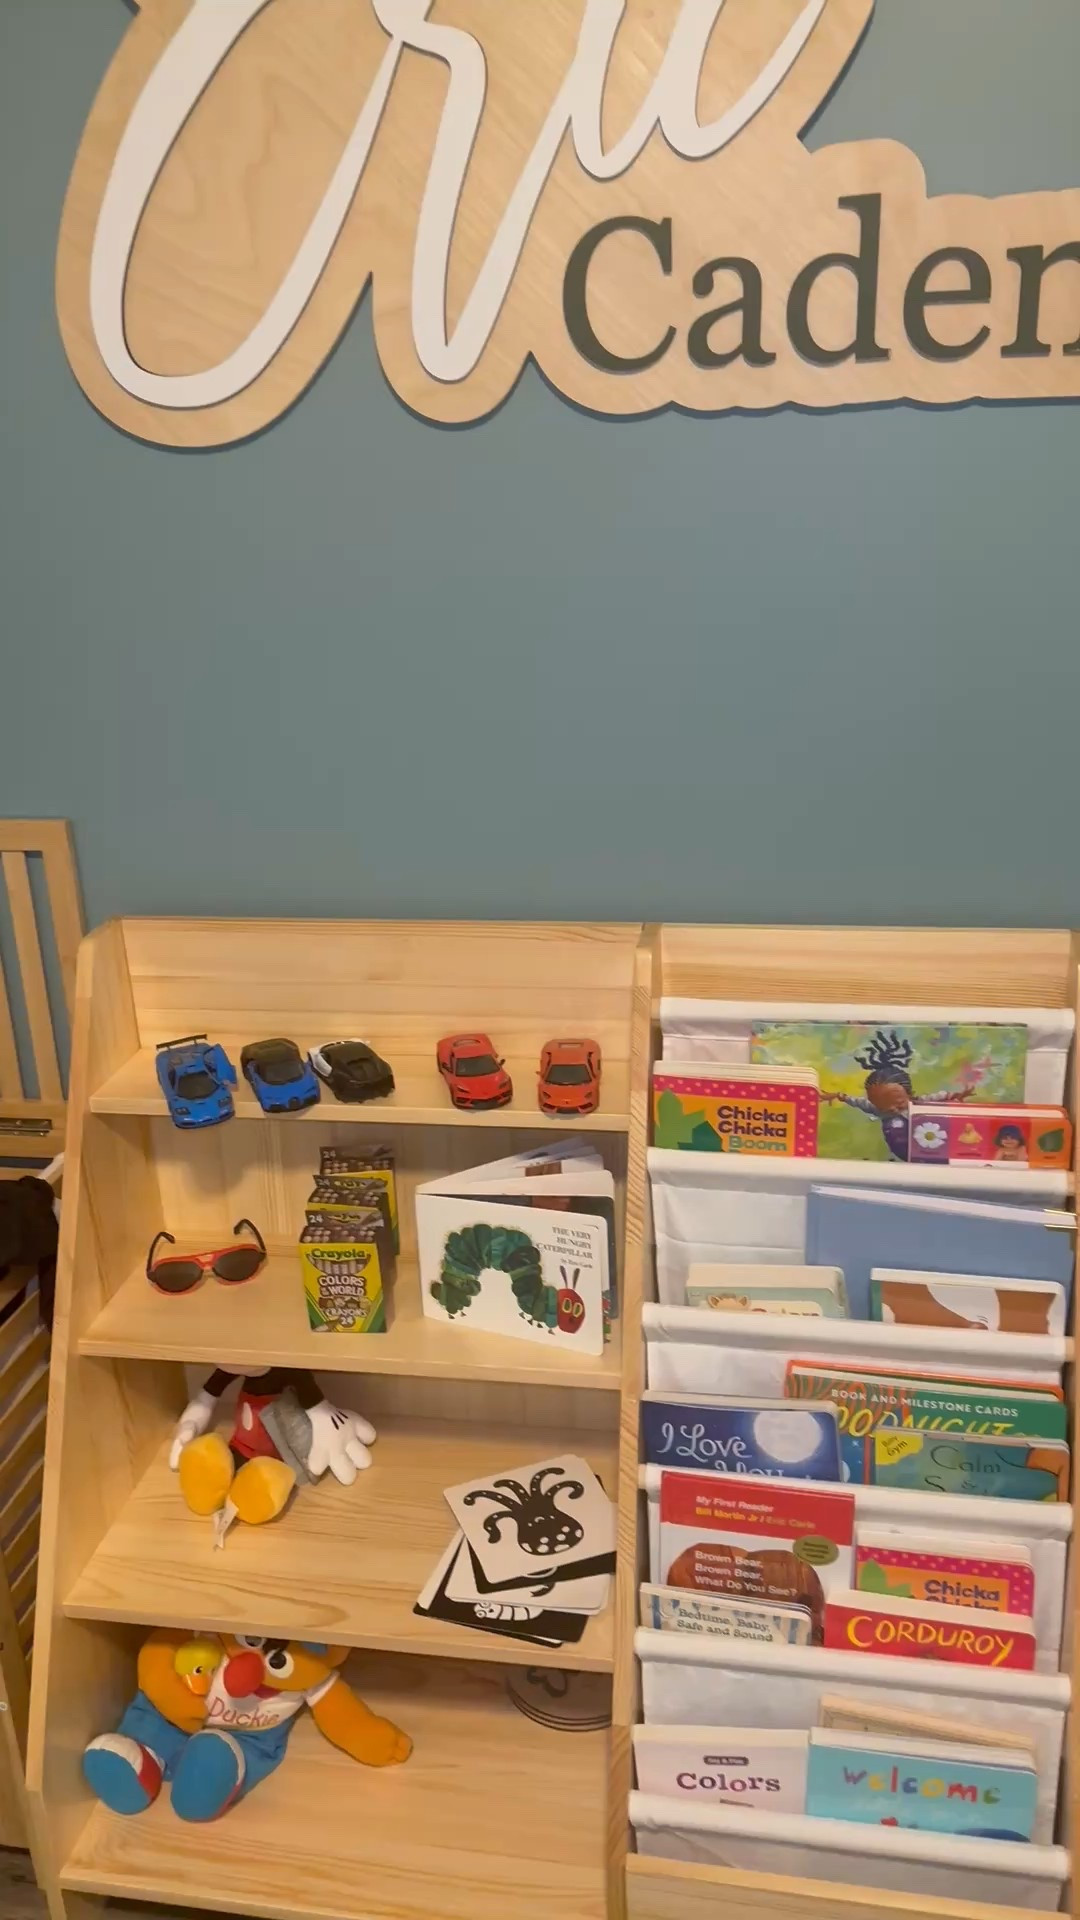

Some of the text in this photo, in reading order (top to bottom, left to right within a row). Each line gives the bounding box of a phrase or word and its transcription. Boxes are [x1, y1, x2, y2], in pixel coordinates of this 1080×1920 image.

[562, 192, 1080, 373] Caden
[717, 1105, 788, 1124] Chicka
[718, 1120, 787, 1138] Chicka
[729, 1136, 787, 1151] Boom
[309, 1214, 323, 1223] 24
[552, 1226, 591, 1240] THE VERY
[536, 1242, 593, 1259] CATERPILLAR
[557, 1236, 592, 1250] HUNGRY
[311, 1248, 366, 1260] Crayola
[319, 1275, 365, 1287] COLORS
[328, 1286, 364, 1296] WORLD
[831, 1388, 1019, 1418] BOOK AND MILESTONE CARDS
[656, 1422, 752, 1463] I Love
[887, 1440, 908, 1457] Gym
[930, 1445, 1001, 1473] Calm
[695, 1495, 774, 1513] My First Reader
[695, 1506, 712, 1516] Bill
[714, 1508, 745, 1521] Martin
[694, 1550, 764, 1569] Brown Bear,
[694, 1563, 764, 1581] Brown Bear,
[694, 1575, 798, 1597] What Do You See?
[924, 1578, 1000, 1602] Chicka
[676, 1619, 774, 1643] Safe and Sound
[846, 1615, 1015, 1667] CORDUROY
[676, 1772, 781, 1793] Colors
[843, 1765, 1002, 1805] welcome
